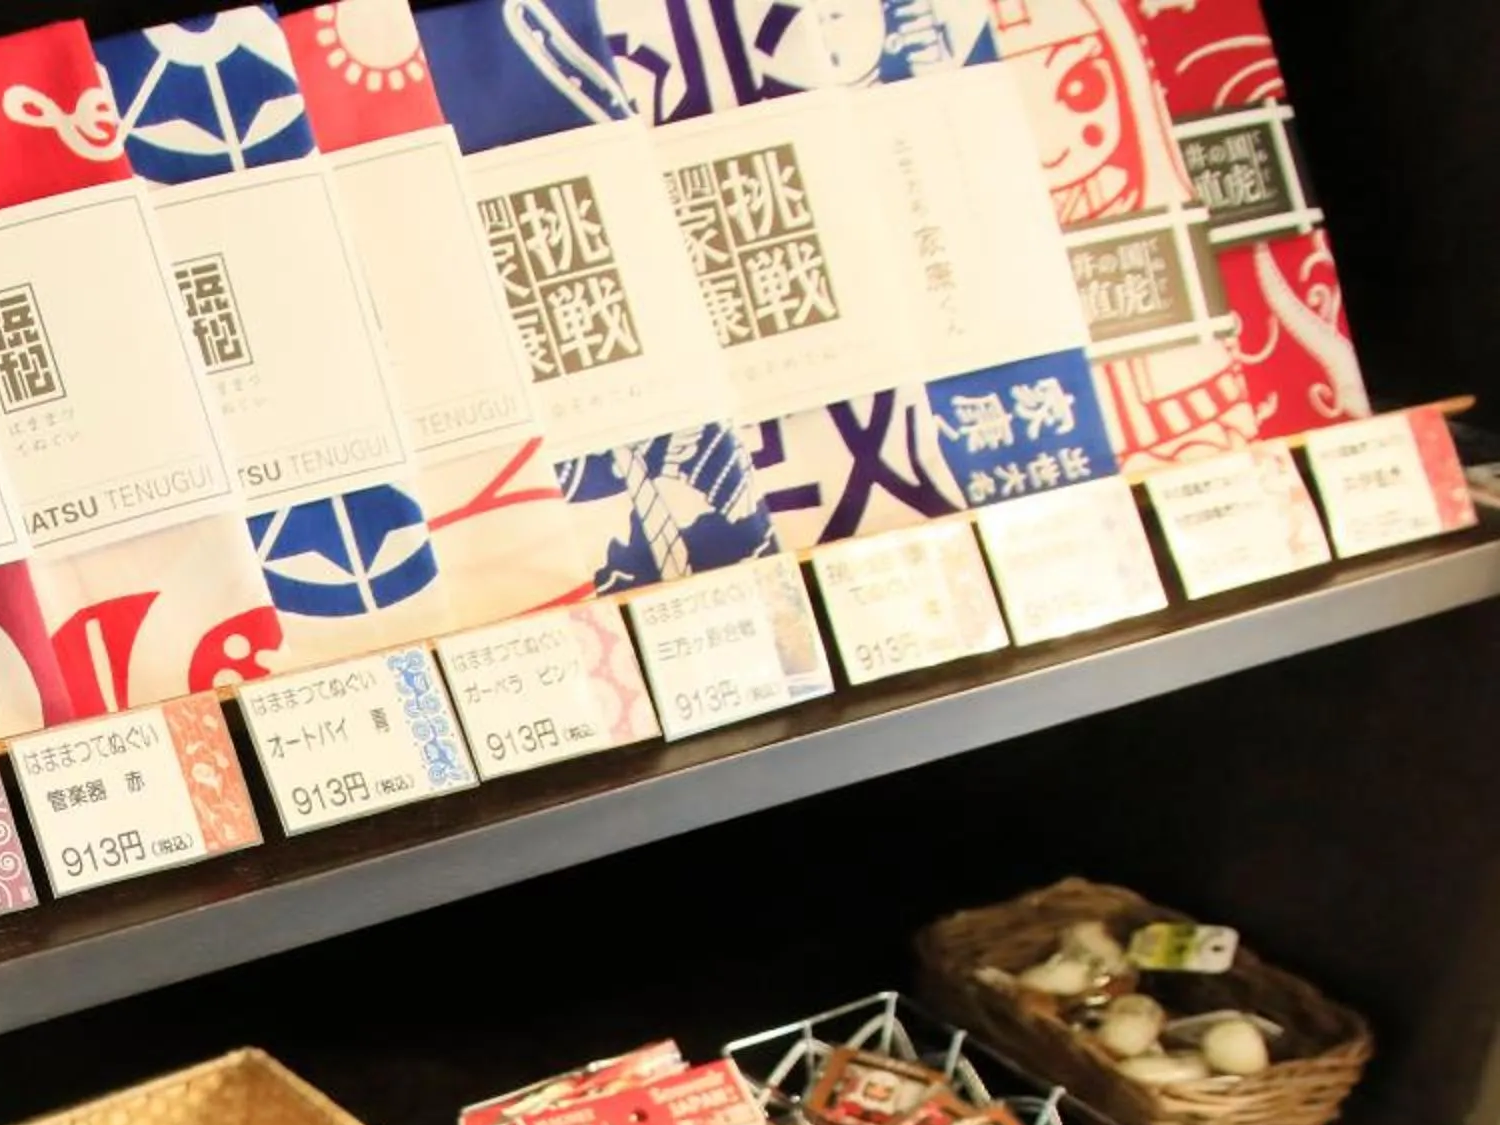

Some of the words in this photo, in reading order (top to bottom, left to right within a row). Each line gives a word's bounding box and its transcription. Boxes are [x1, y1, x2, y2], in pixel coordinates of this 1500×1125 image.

[416, 393, 519, 438] TENUGUI
[290, 434, 391, 475] TENUGUI
[23, 495, 99, 536] ATSU
[104, 464, 215, 510] TENUGUI
[251, 669, 379, 717] はままつてぬぐい
[674, 678, 742, 721] 913円
[24, 723, 160, 776] はままつてぬぐい
[266, 716, 350, 760] オートバイ
[485, 717, 560, 761] 913円
[124, 770, 147, 794] 赤
[291, 770, 372, 815] 913円
[60, 829, 148, 877] 913円
